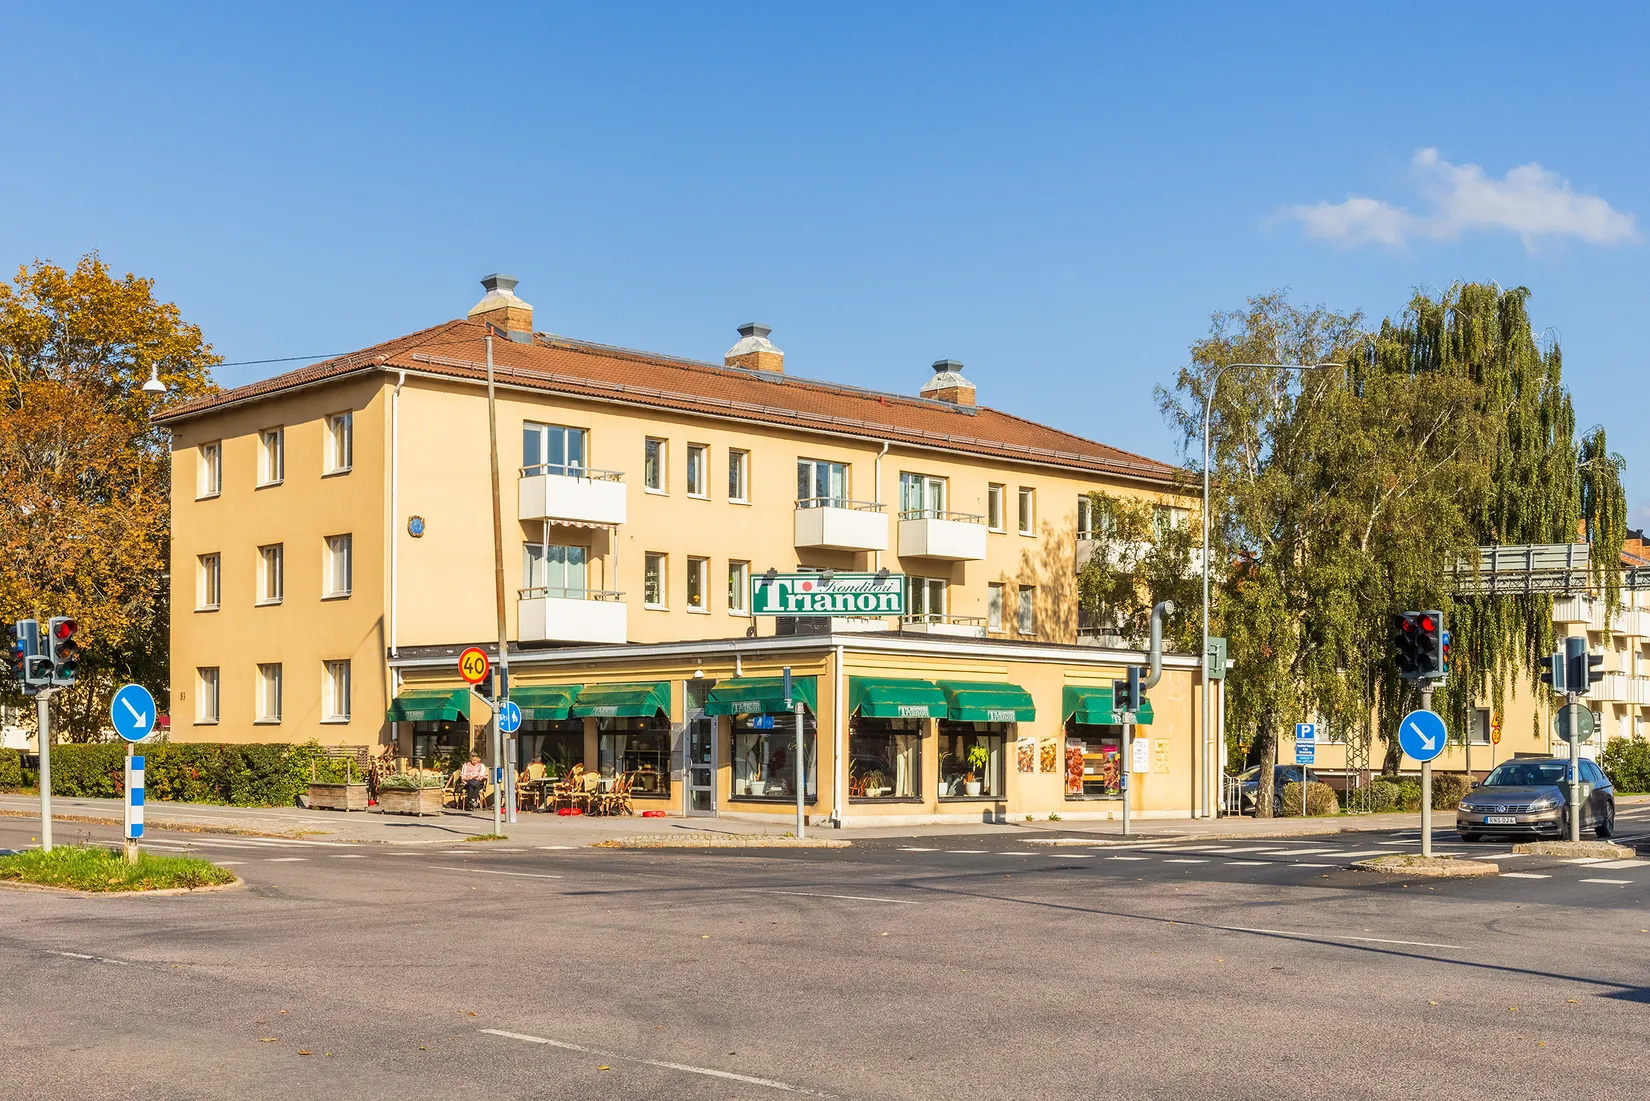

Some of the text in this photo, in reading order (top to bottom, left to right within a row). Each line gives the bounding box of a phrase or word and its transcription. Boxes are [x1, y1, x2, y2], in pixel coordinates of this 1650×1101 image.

[820, 580, 894, 593] Konditori
[755, 580, 900, 611] Trianon
[463, 657, 485, 675] 40
[1301, 725, 1311, 738] P
